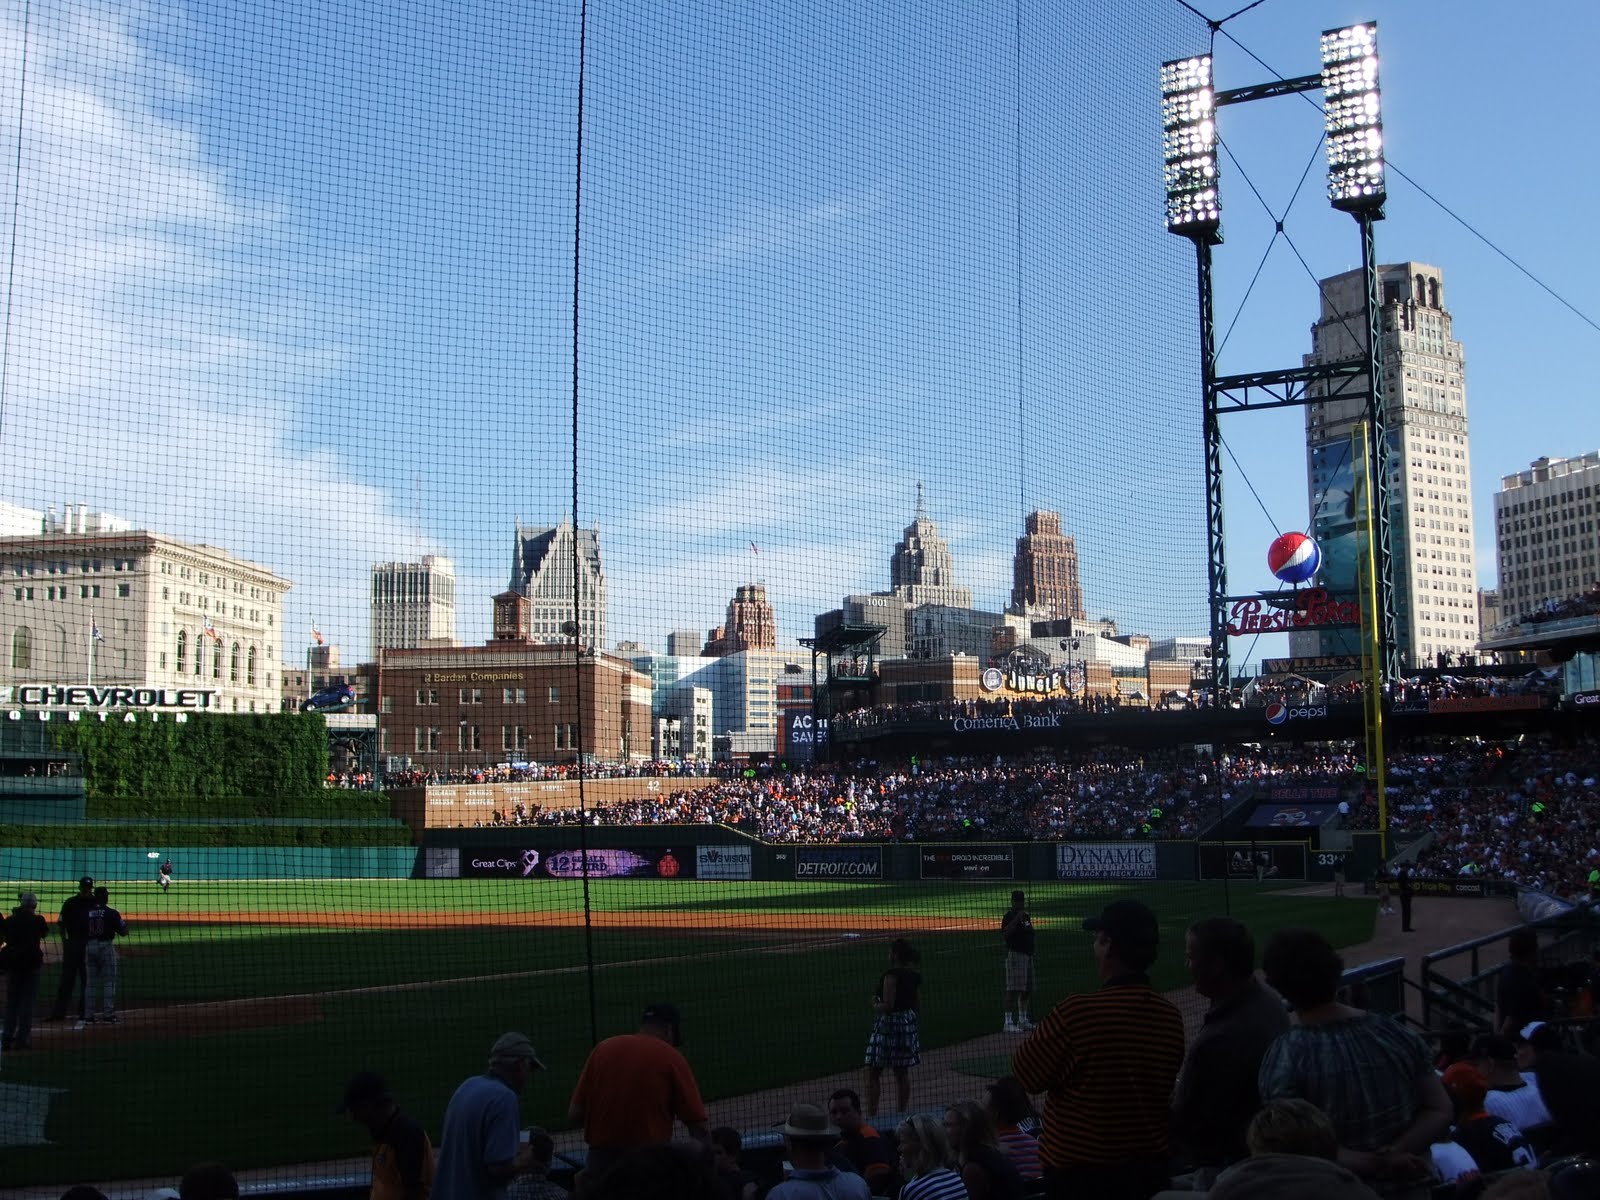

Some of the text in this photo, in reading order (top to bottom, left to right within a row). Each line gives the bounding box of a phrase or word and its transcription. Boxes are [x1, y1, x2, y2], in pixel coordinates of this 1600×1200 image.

[868, 598, 887, 606] 1001
[1227, 598, 1290, 636] PEPSI
[434, 672, 524, 682] Barden Companies
[1008, 670, 1059, 693] JUNGLE
[20, 686, 217, 707] CHEVROLET
[1574, 693, 1600, 704] Great
[1289, 705, 1327, 719] pepsi
[1023, 713, 1061, 728] Bank
[647, 780, 660, 791] 42
[724, 855, 750, 863] VISION
[1060, 846, 1152, 864] DYNAMIC
[471, 858, 517, 871] Great Cips
[551, 856, 570, 871] 12
[797, 862, 877, 874] DETROIT.COM
